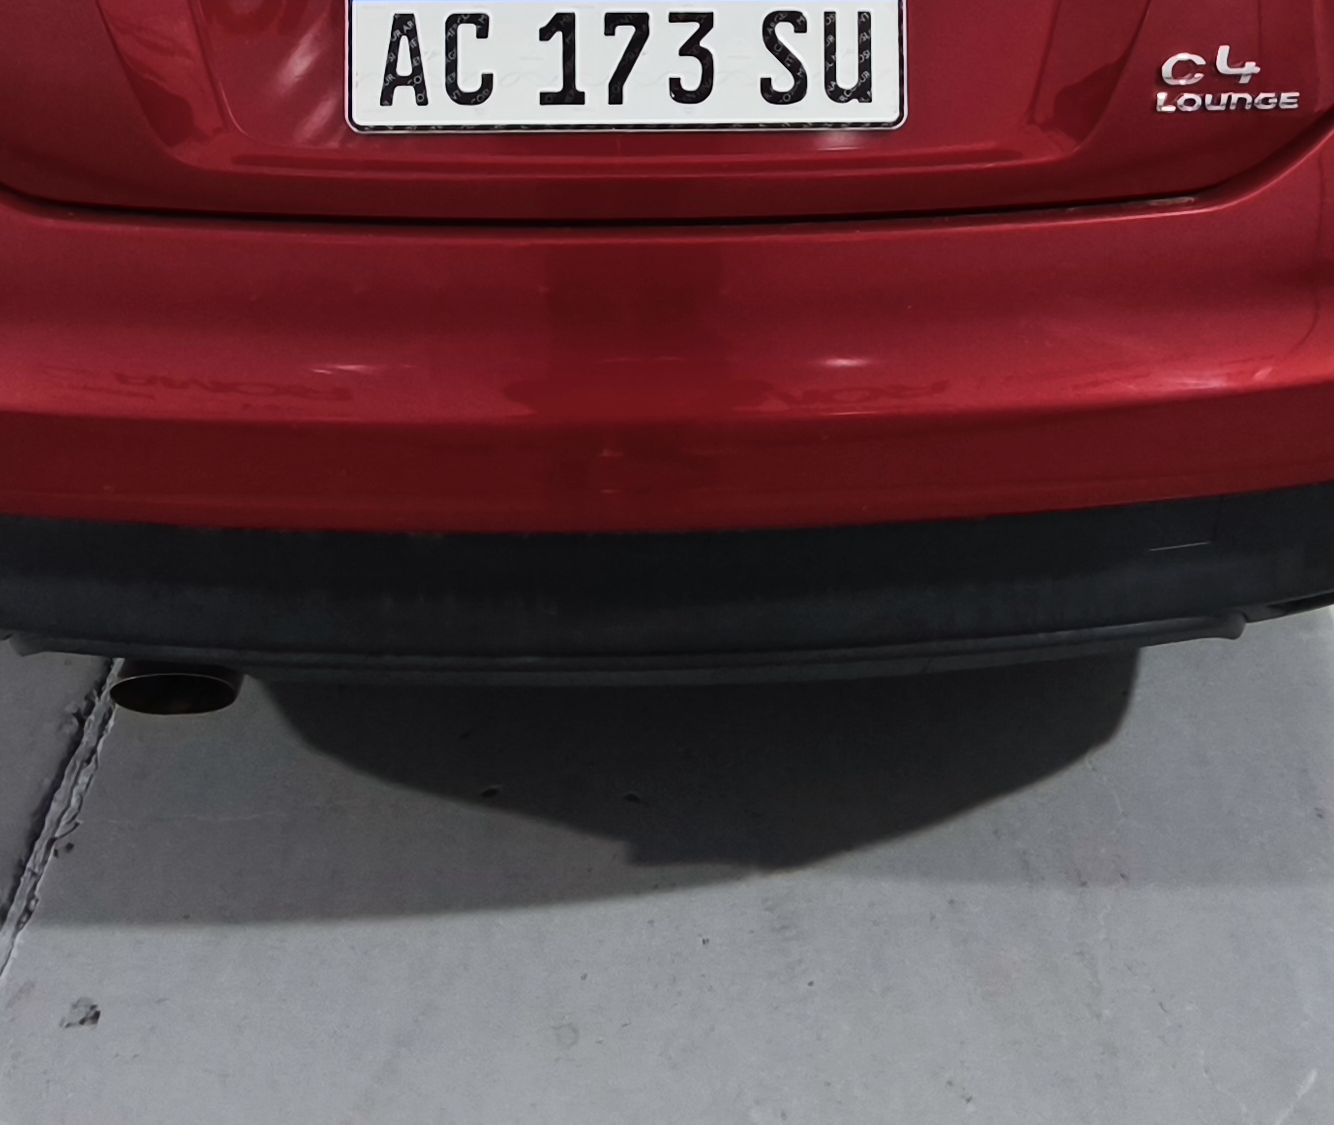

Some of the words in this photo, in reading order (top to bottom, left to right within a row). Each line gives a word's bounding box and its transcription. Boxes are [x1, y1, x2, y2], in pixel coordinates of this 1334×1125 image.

[380, 13, 495, 106] AC
[539, 12, 714, 105] 173
[760, 10, 873, 106] SU
[1161, 45, 1261, 85] C4
[1156, 92, 1300, 113] LOUNGE
